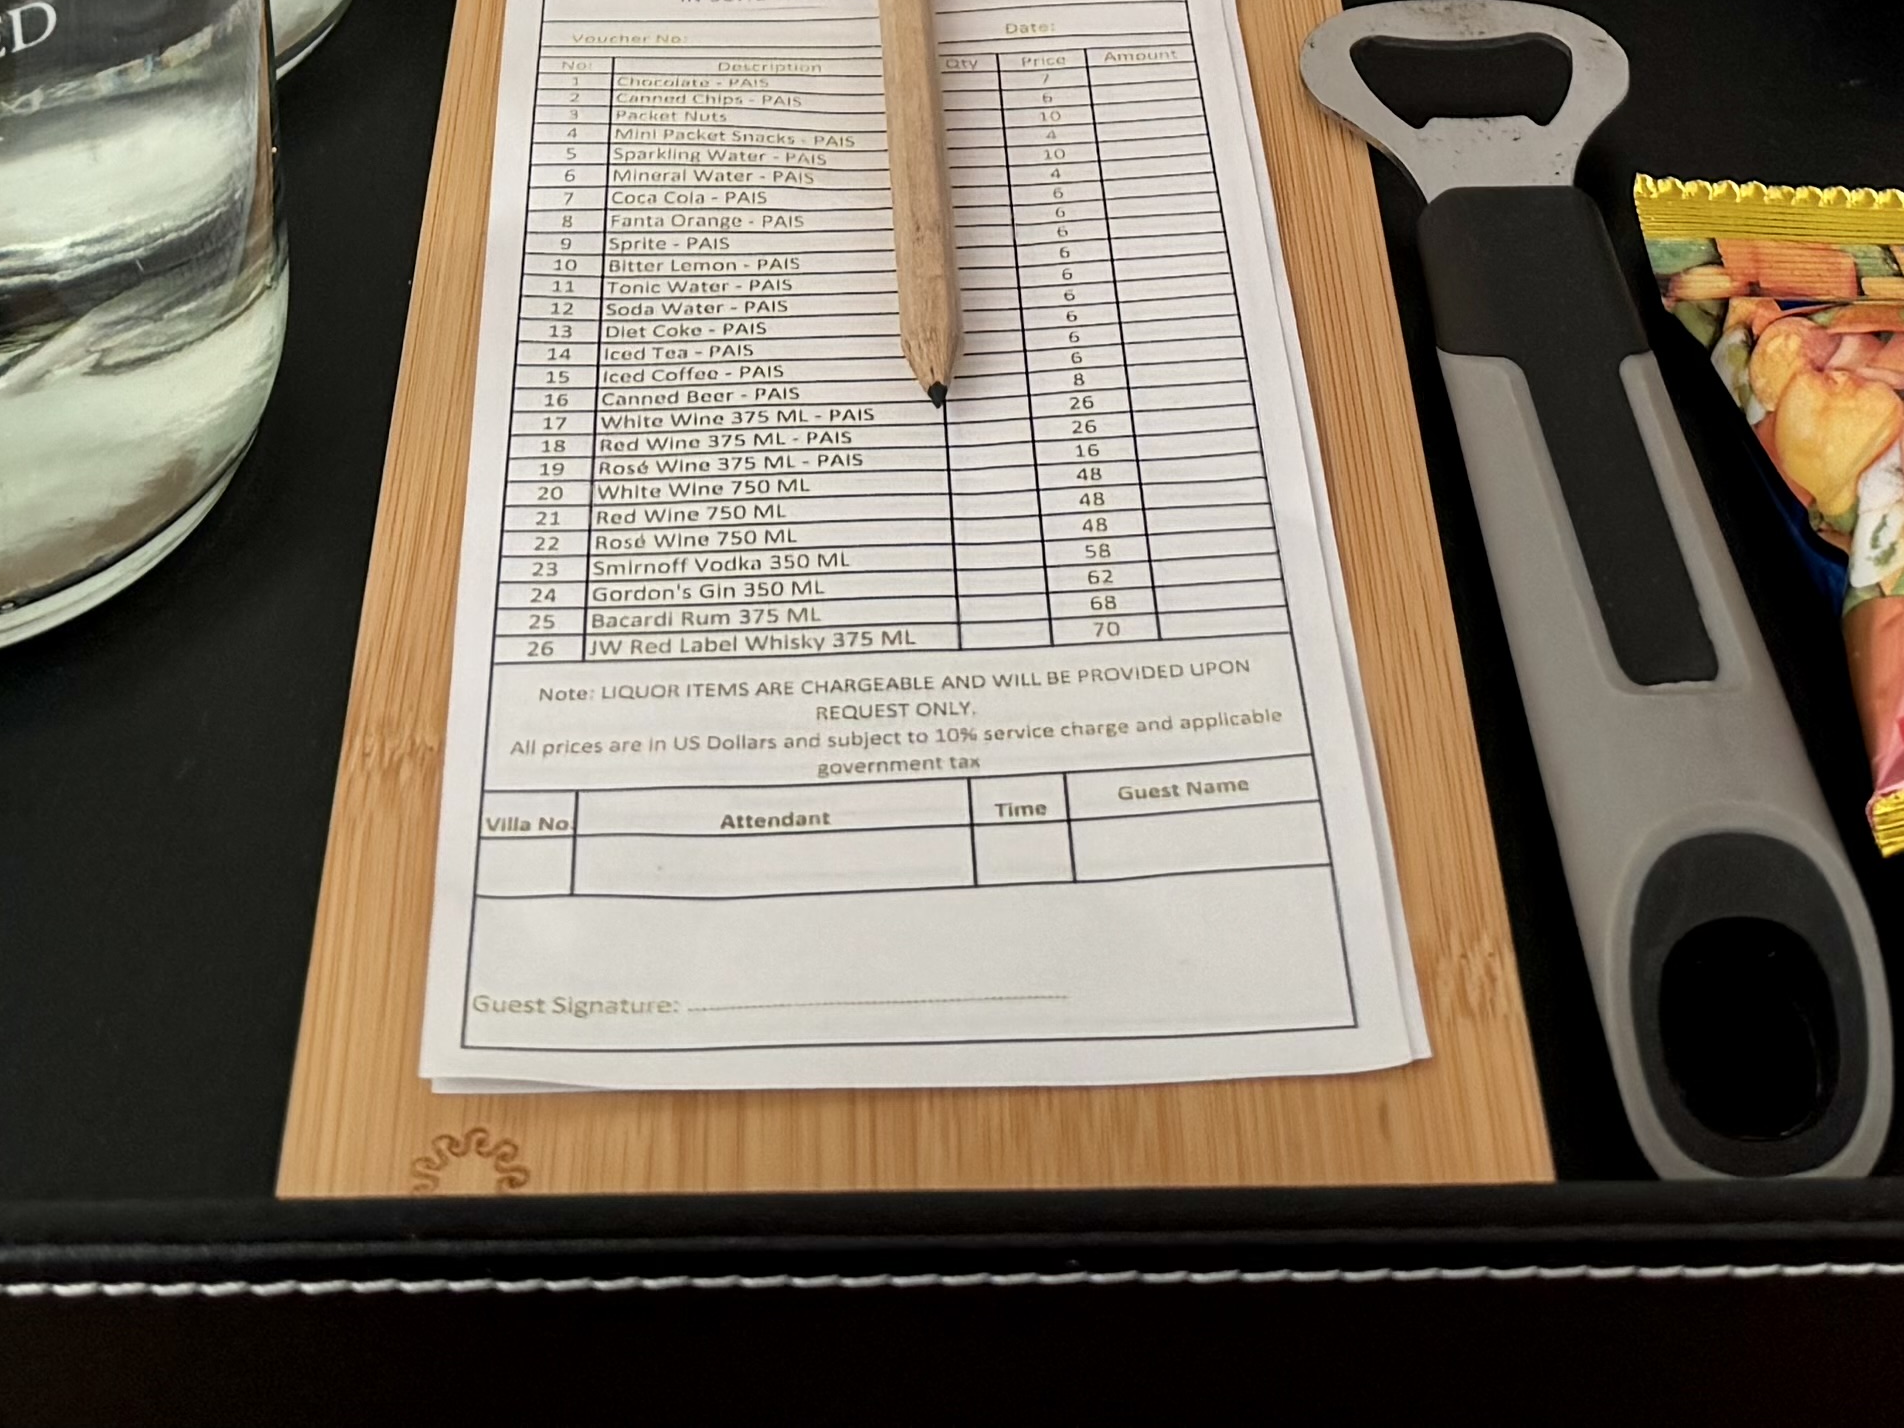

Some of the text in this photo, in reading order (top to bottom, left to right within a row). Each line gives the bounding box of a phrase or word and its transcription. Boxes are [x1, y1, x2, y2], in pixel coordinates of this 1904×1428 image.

[1006, 23, 1056, 34] Date:
[1021, 56, 1066, 67] Price
[1104, 50, 1177, 62] Amount
[718, 62, 822, 73] Description
[611, 215, 804, 230] Fanta Orange PAIS
[606, 322, 767, 338] Diet Coke PAIS
[604, 345, 754, 361] Iced Tea PAIS
[603, 366, 784, 383] Iced Coffee PAIS
[601, 387, 800, 406] Canned Beer PAIS
[601, 407, 874, 429] White Wine 375 ML PAIS
[600, 431, 852, 452] Red Wine 375 ML PAIS
[599, 453, 863, 475] Rosé Wine 375 ML PAIS
[597, 479, 810, 500] White Wine 750 ML
[597, 504, 786, 525] Red Wine 750 ML
[595, 529, 797, 550] Rosé Wine 750 ML
[1086, 544, 1111, 558] 58
[593, 552, 849, 577] Smirnoff Vodka 350 ML
[1088, 570, 1114, 584] 62
[593, 579, 825, 603] Gordon's Gin 350 ML
[1091, 596, 1117, 610] 68
[592, 607, 821, 628] Bacardi Rum 375 ML
[1094, 622, 1120, 637] 70
[589, 630, 916, 656] JW Red Label Whisky 375 ML
[538, 660, 1250, 702] Note: LIQUOR ITEMS ARE CHARGEABLE AND WILL BE PROVIDED UPON
[816, 703, 910, 720] REQUEST
[510, 709, 1282, 758] All prices are in US Dollars and subject to 10% service charge and applicable
[817, 755, 980, 779] government tax
[1118, 778, 1249, 801] Guest Name
[995, 802, 1047, 817] Time
[486, 817, 531, 832] Villa
[720, 812, 830, 829] Attendant
[473, 995, 680, 1018] Guest Signature:
